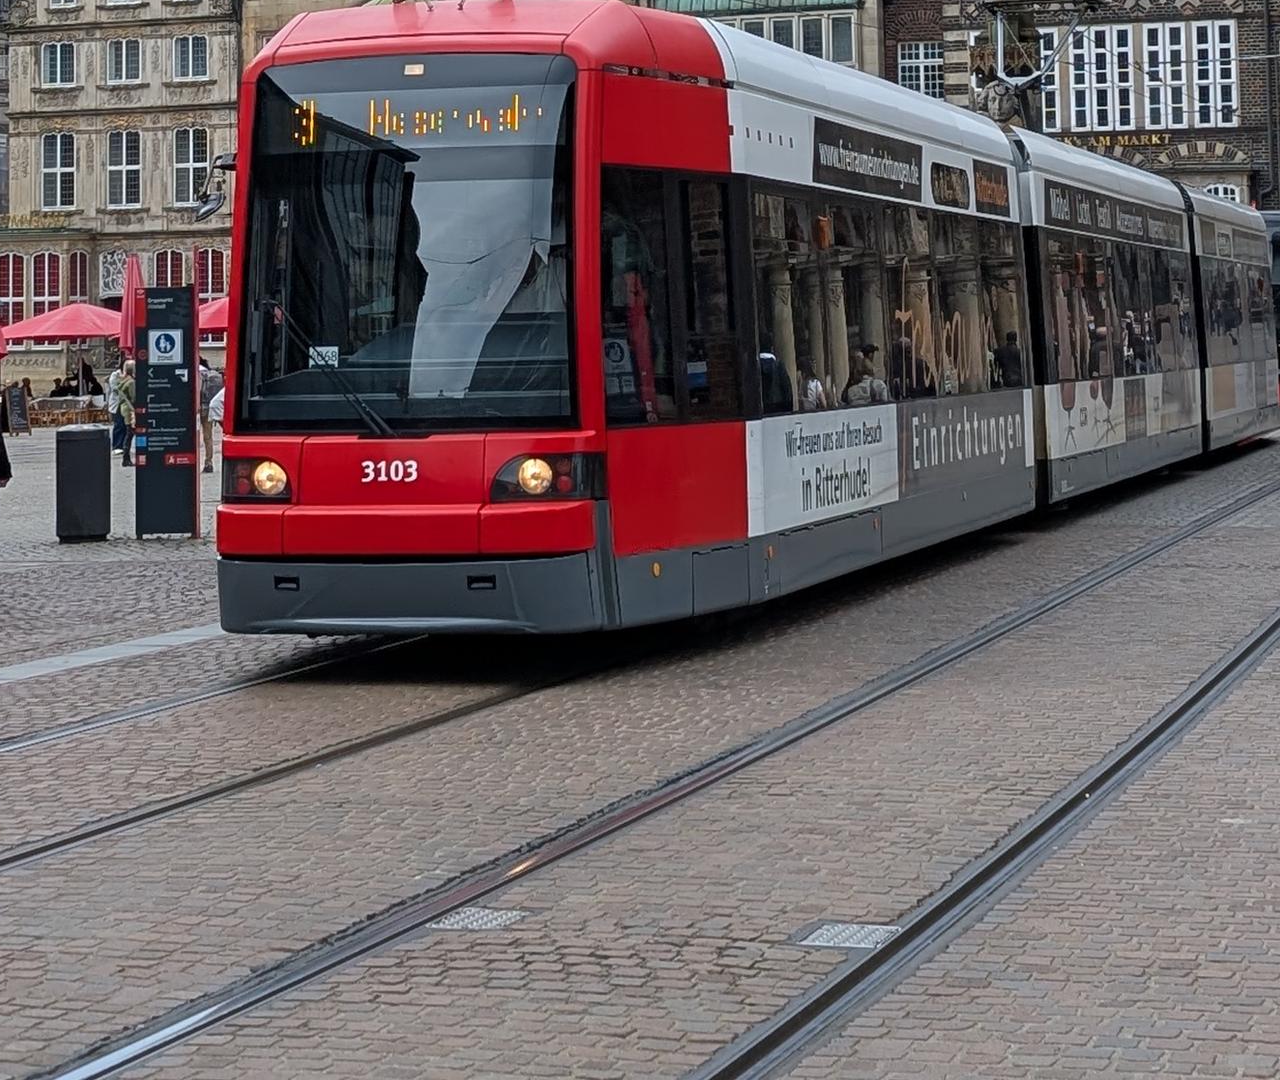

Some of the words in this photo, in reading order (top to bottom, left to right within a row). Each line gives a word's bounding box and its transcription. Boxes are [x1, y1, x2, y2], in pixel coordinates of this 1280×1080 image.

[1088, 136, 1110, 147] AM
[1117, 133, 1172, 146] MARKT
[822, 432, 835, 451] uns
[835, 422, 845, 450] auf
[911, 406, 1022, 470] Einrichtungen
[361, 460, 418, 483] 3103
[801, 466, 813, 512] in
[815, 456, 872, 509] Ritterhude!
